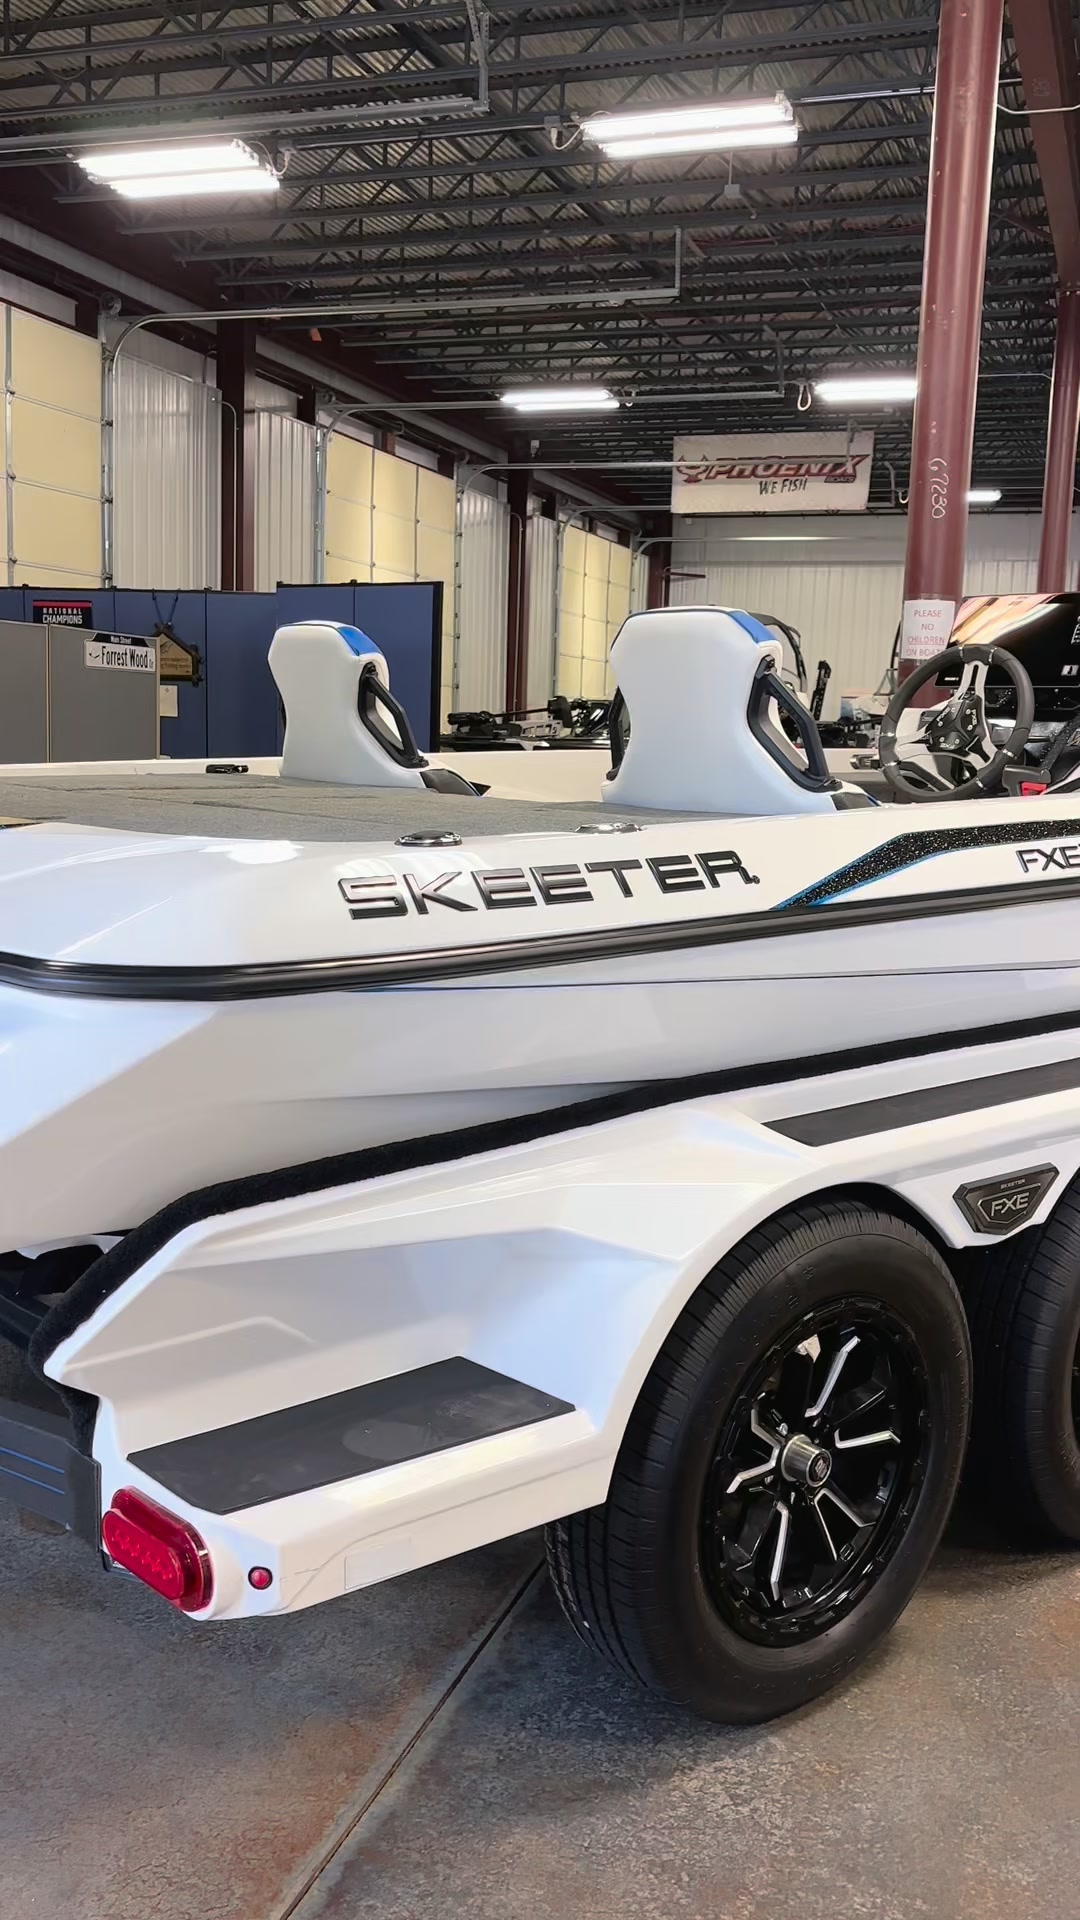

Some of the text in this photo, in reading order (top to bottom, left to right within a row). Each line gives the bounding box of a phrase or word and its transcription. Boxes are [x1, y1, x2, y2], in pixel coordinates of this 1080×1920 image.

[705, 455, 870, 480] PHOENIX
[824, 475, 856, 484] BOATS
[758, 478, 808, 496] WE FISH
[913, 609, 942, 618] PLEASE
[42, 615, 83, 624] CHAMPIONS
[921, 623, 935, 631] NO
[120, 637, 132, 645] Street
[907, 636, 945, 646] CHILDREN
[101, 646, 128, 667] Forrest
[129, 648, 148, 669] Wood
[919, 649, 941, 657] BOAT
[1018, 846, 1080, 873] FXE
[337, 850, 754, 920] SKEETER
[1000, 1179, 1026, 1190] SKEETER
[991, 1192, 1029, 1216] FXE
